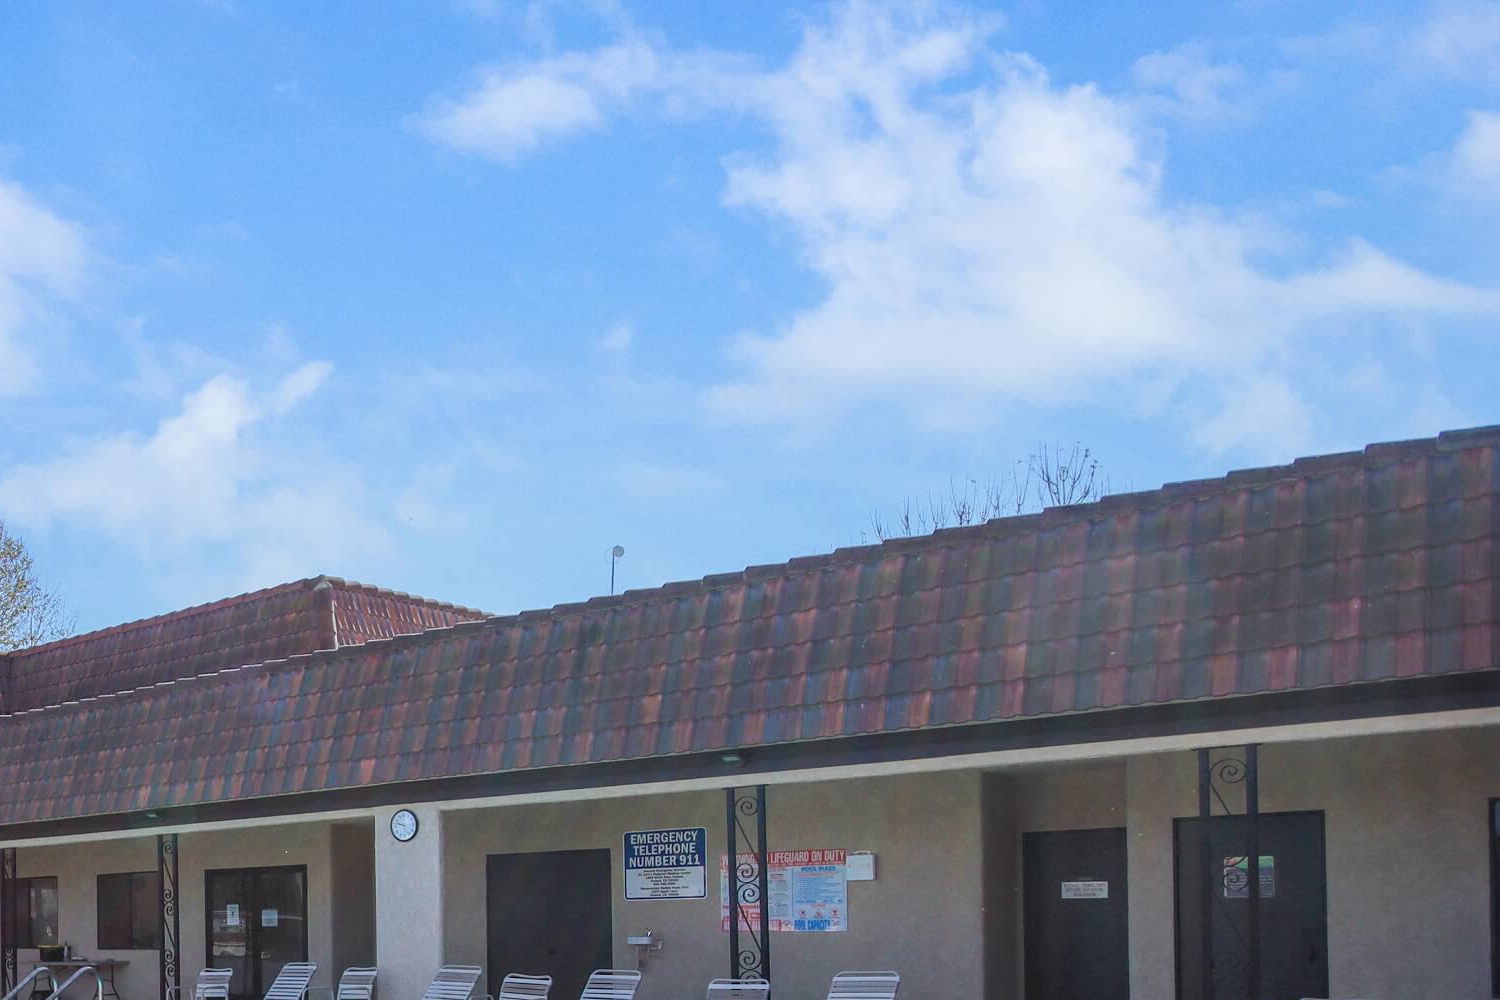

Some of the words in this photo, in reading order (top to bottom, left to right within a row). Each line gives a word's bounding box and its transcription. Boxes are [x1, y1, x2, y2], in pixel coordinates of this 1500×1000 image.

[630, 830, 698, 845] EMERGENCY
[633, 842, 696, 856] TELEPHONE
[629, 855, 677, 868] NUMBER
[679, 854, 700, 866] 911
[770, 851, 809, 864] LIFEGUARD
[811, 850, 822, 862] ON
[824, 849, 845, 861] DUTY
[795, 919, 807, 931] POOL
[807, 919, 831, 930] CAPACITY
